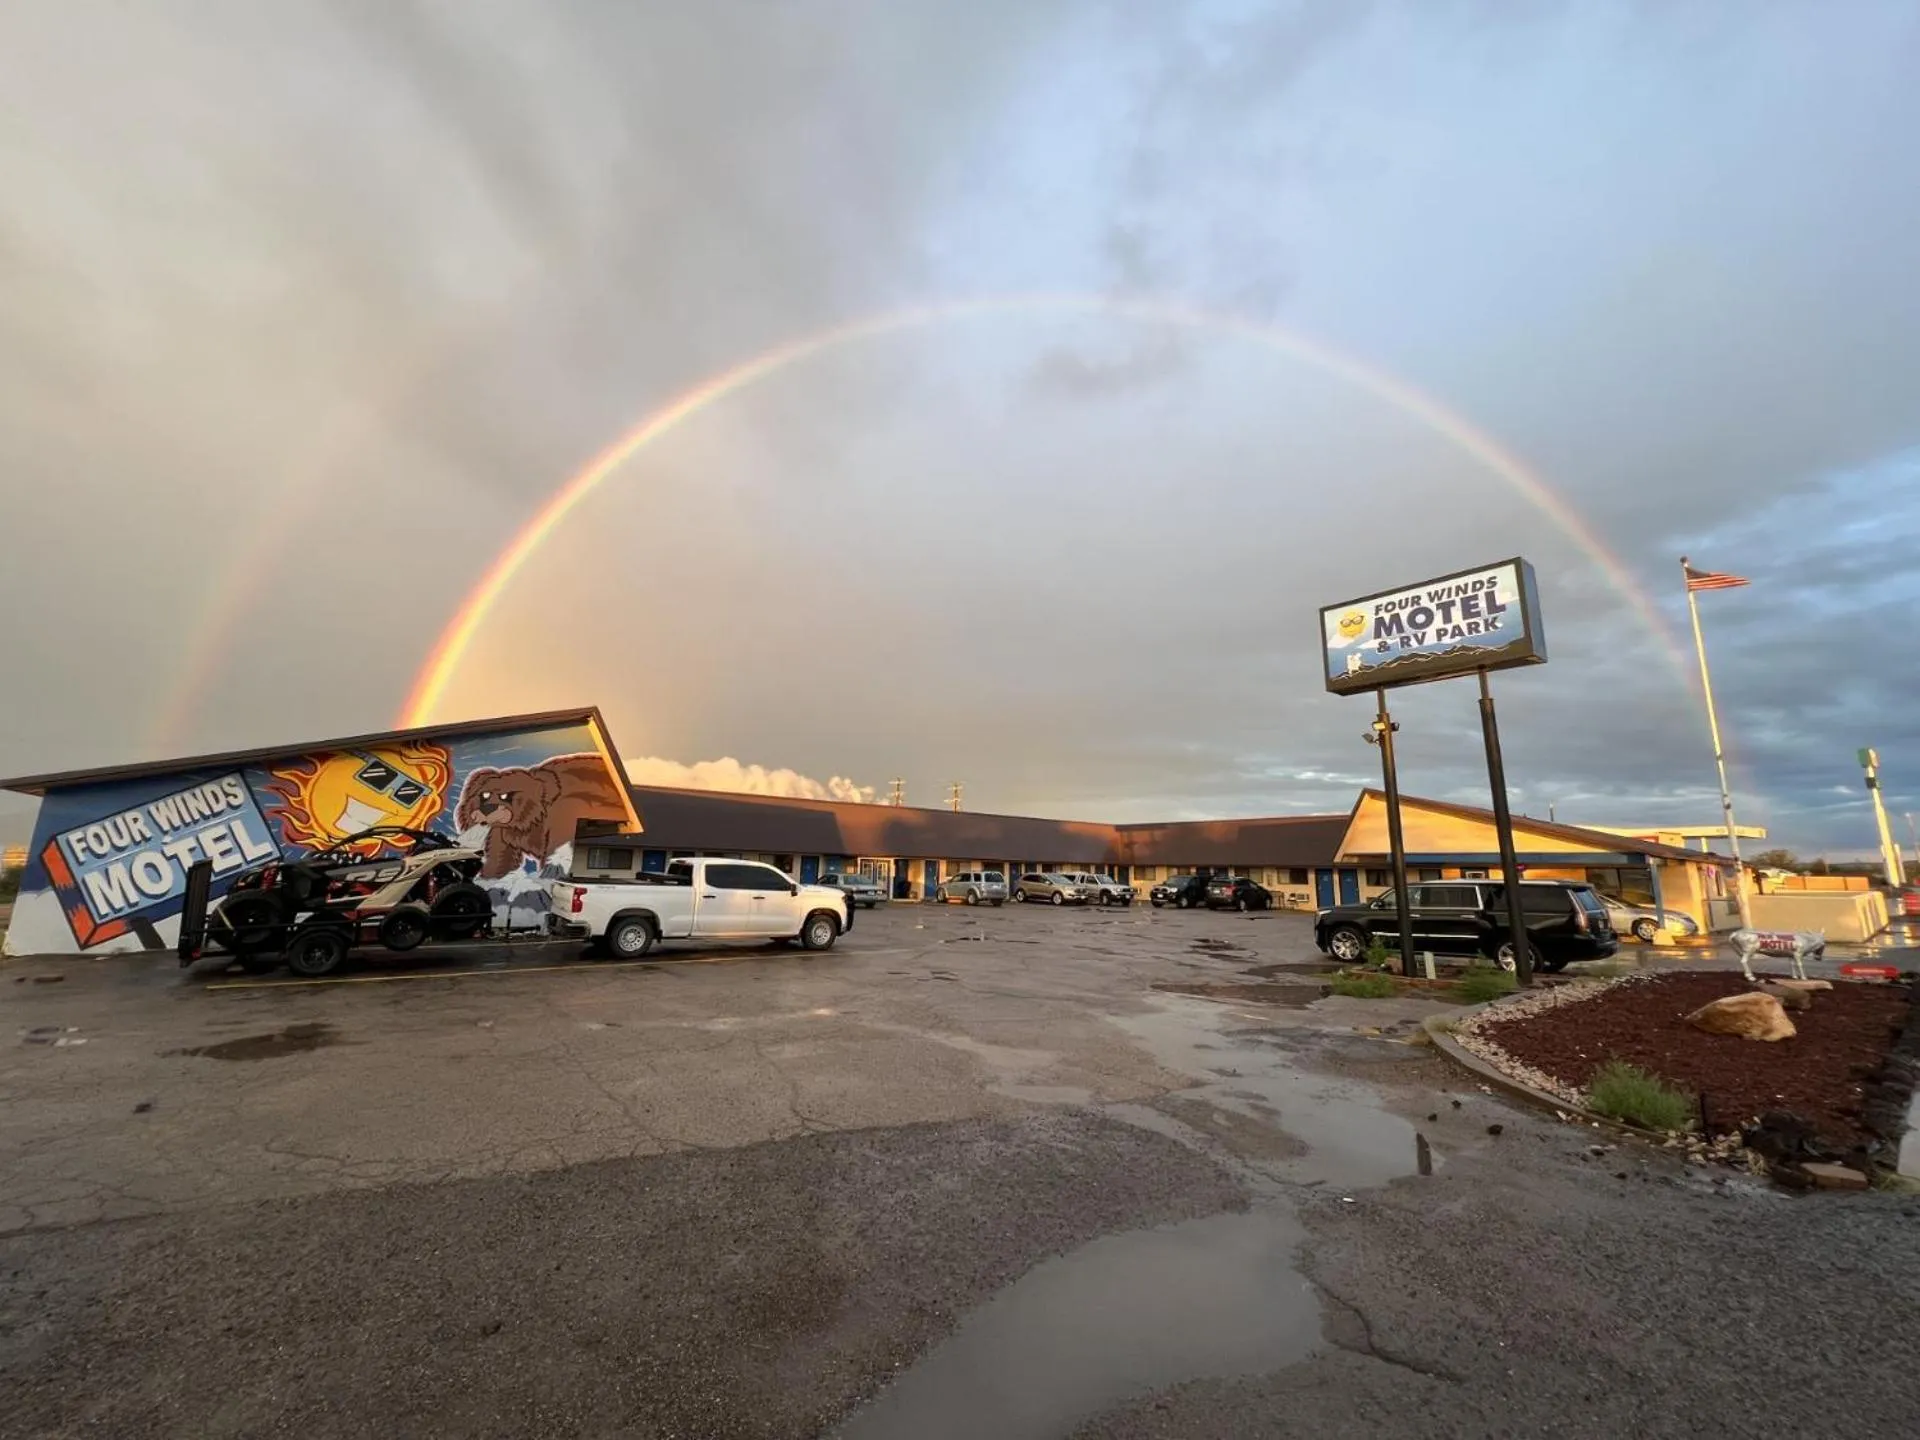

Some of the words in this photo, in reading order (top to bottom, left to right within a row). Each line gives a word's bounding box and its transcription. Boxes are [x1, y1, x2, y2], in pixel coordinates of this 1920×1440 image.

[1374, 591, 1506, 639] MOTEL
[1375, 595, 1422, 615] FOUR
[1428, 576, 1497, 603] WINDS
[1377, 641, 1390, 653] &
[1401, 633, 1426, 648] RV
[1437, 617, 1500, 641] PARK
[68, 811, 152, 863] FOUR
[149, 778, 245, 832] WINDS
[84, 820, 274, 916] MOTEL
